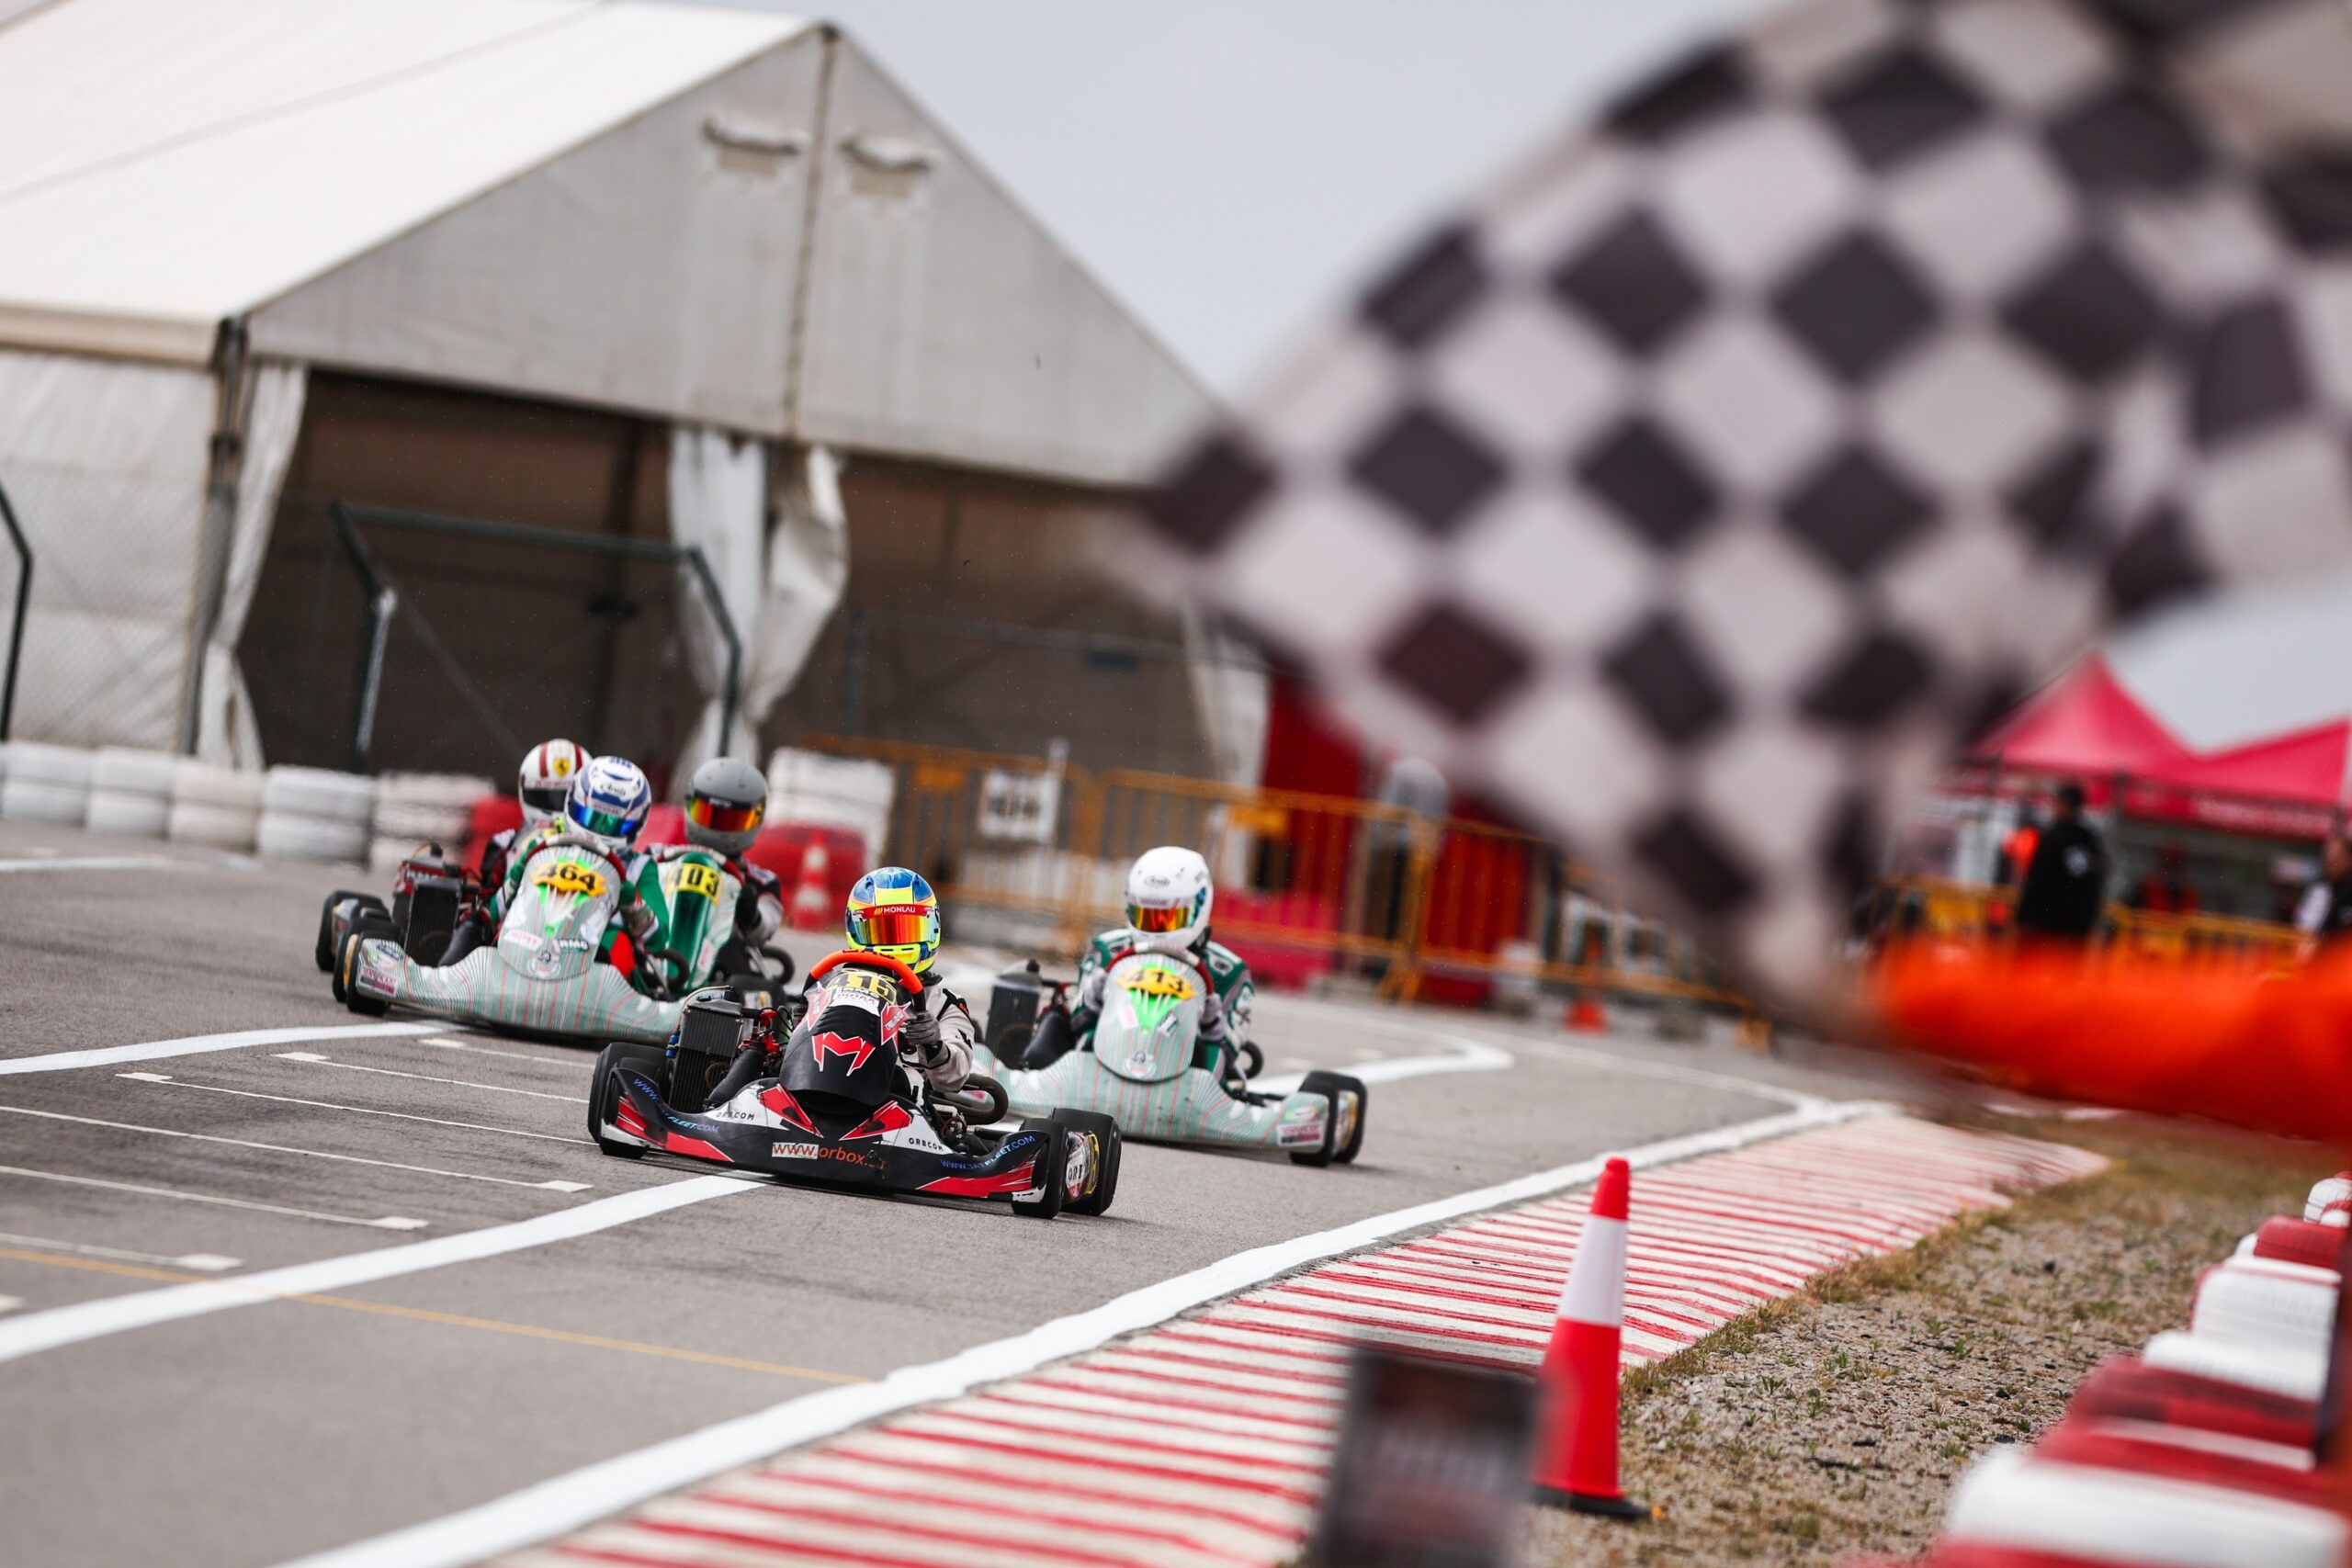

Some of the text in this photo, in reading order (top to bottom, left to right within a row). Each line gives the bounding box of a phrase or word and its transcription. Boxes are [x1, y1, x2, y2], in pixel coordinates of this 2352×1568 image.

[537, 863, 595, 891] 464
[668, 866, 720, 897] 403
[883, 906, 916, 914] MONLAU
[1125, 969, 1184, 993] 413
[908, 1136, 944, 1152] ORBCOM
